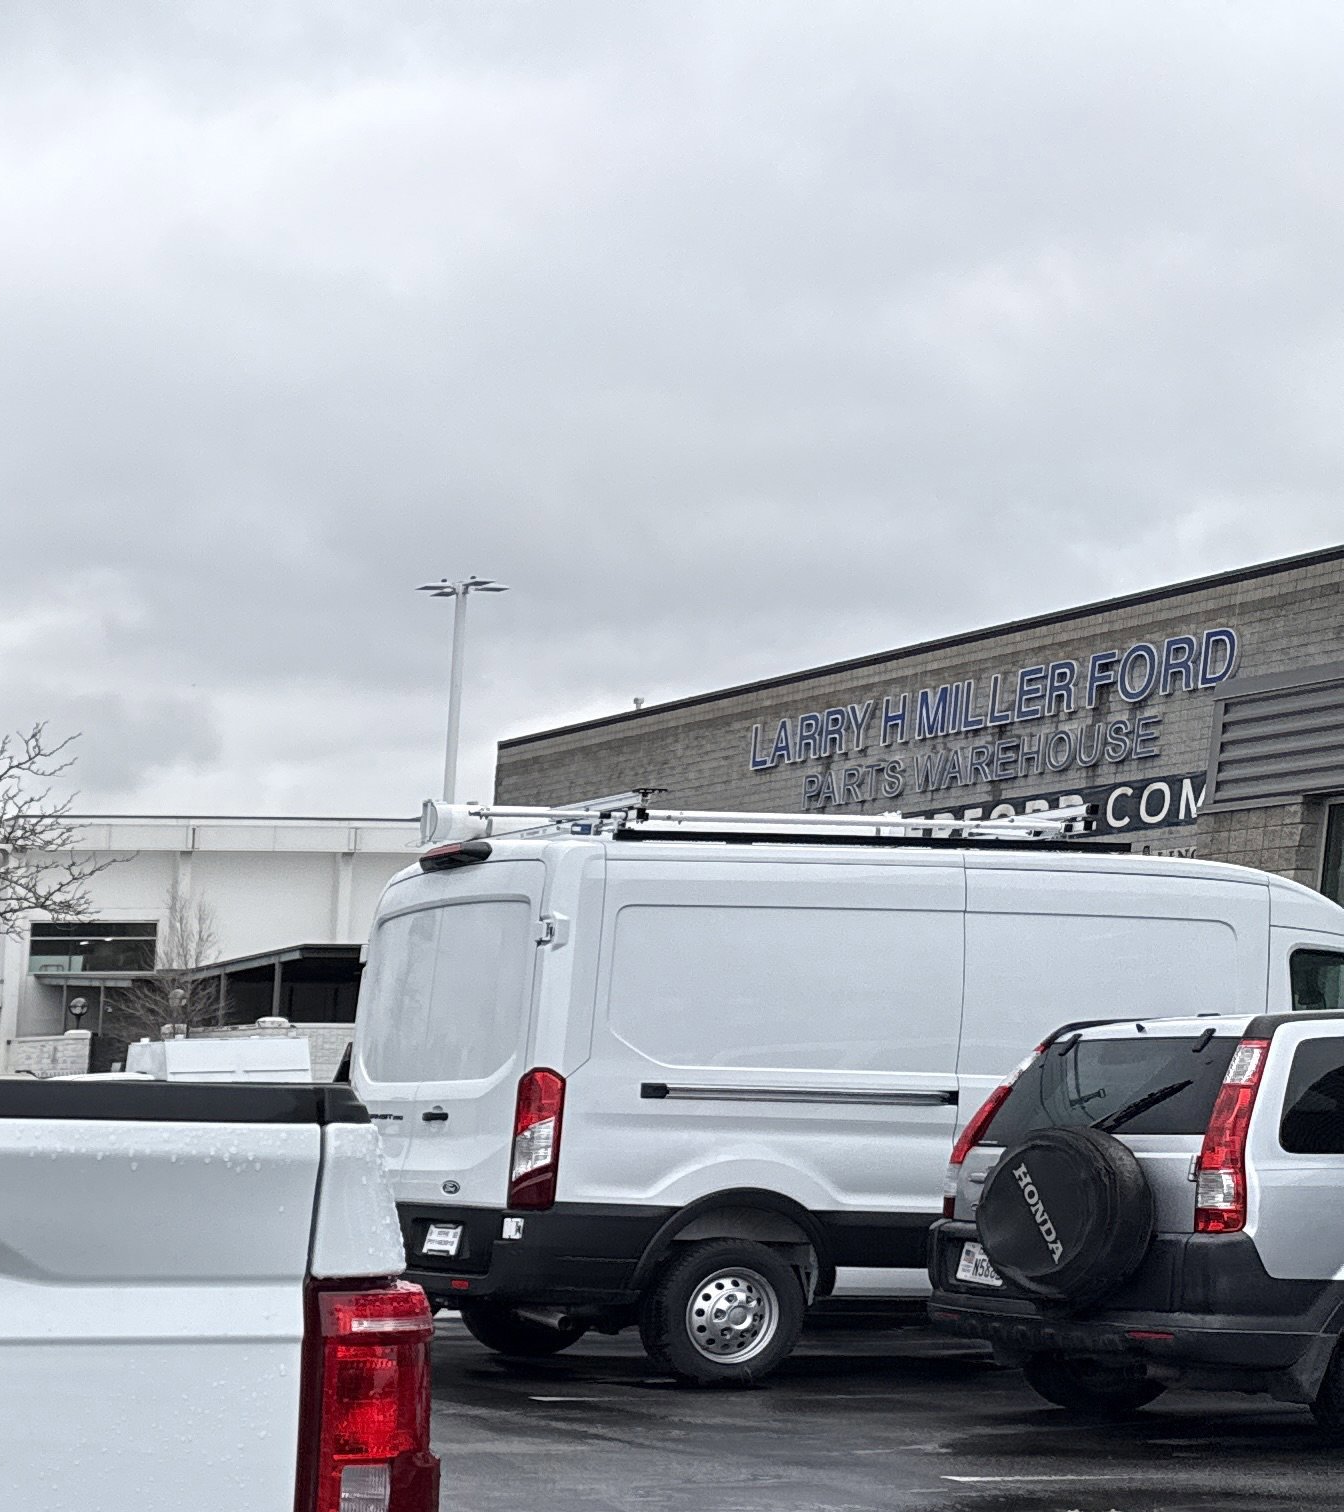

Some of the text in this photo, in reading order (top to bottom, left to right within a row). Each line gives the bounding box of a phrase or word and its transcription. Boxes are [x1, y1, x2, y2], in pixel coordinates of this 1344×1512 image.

[750, 627, 1238, 770] LARRY H MILLER FORD
[801, 714, 1161, 811] PARTS WAREHOUSE
[1013, 1163, 1064, 1265] HONDA
